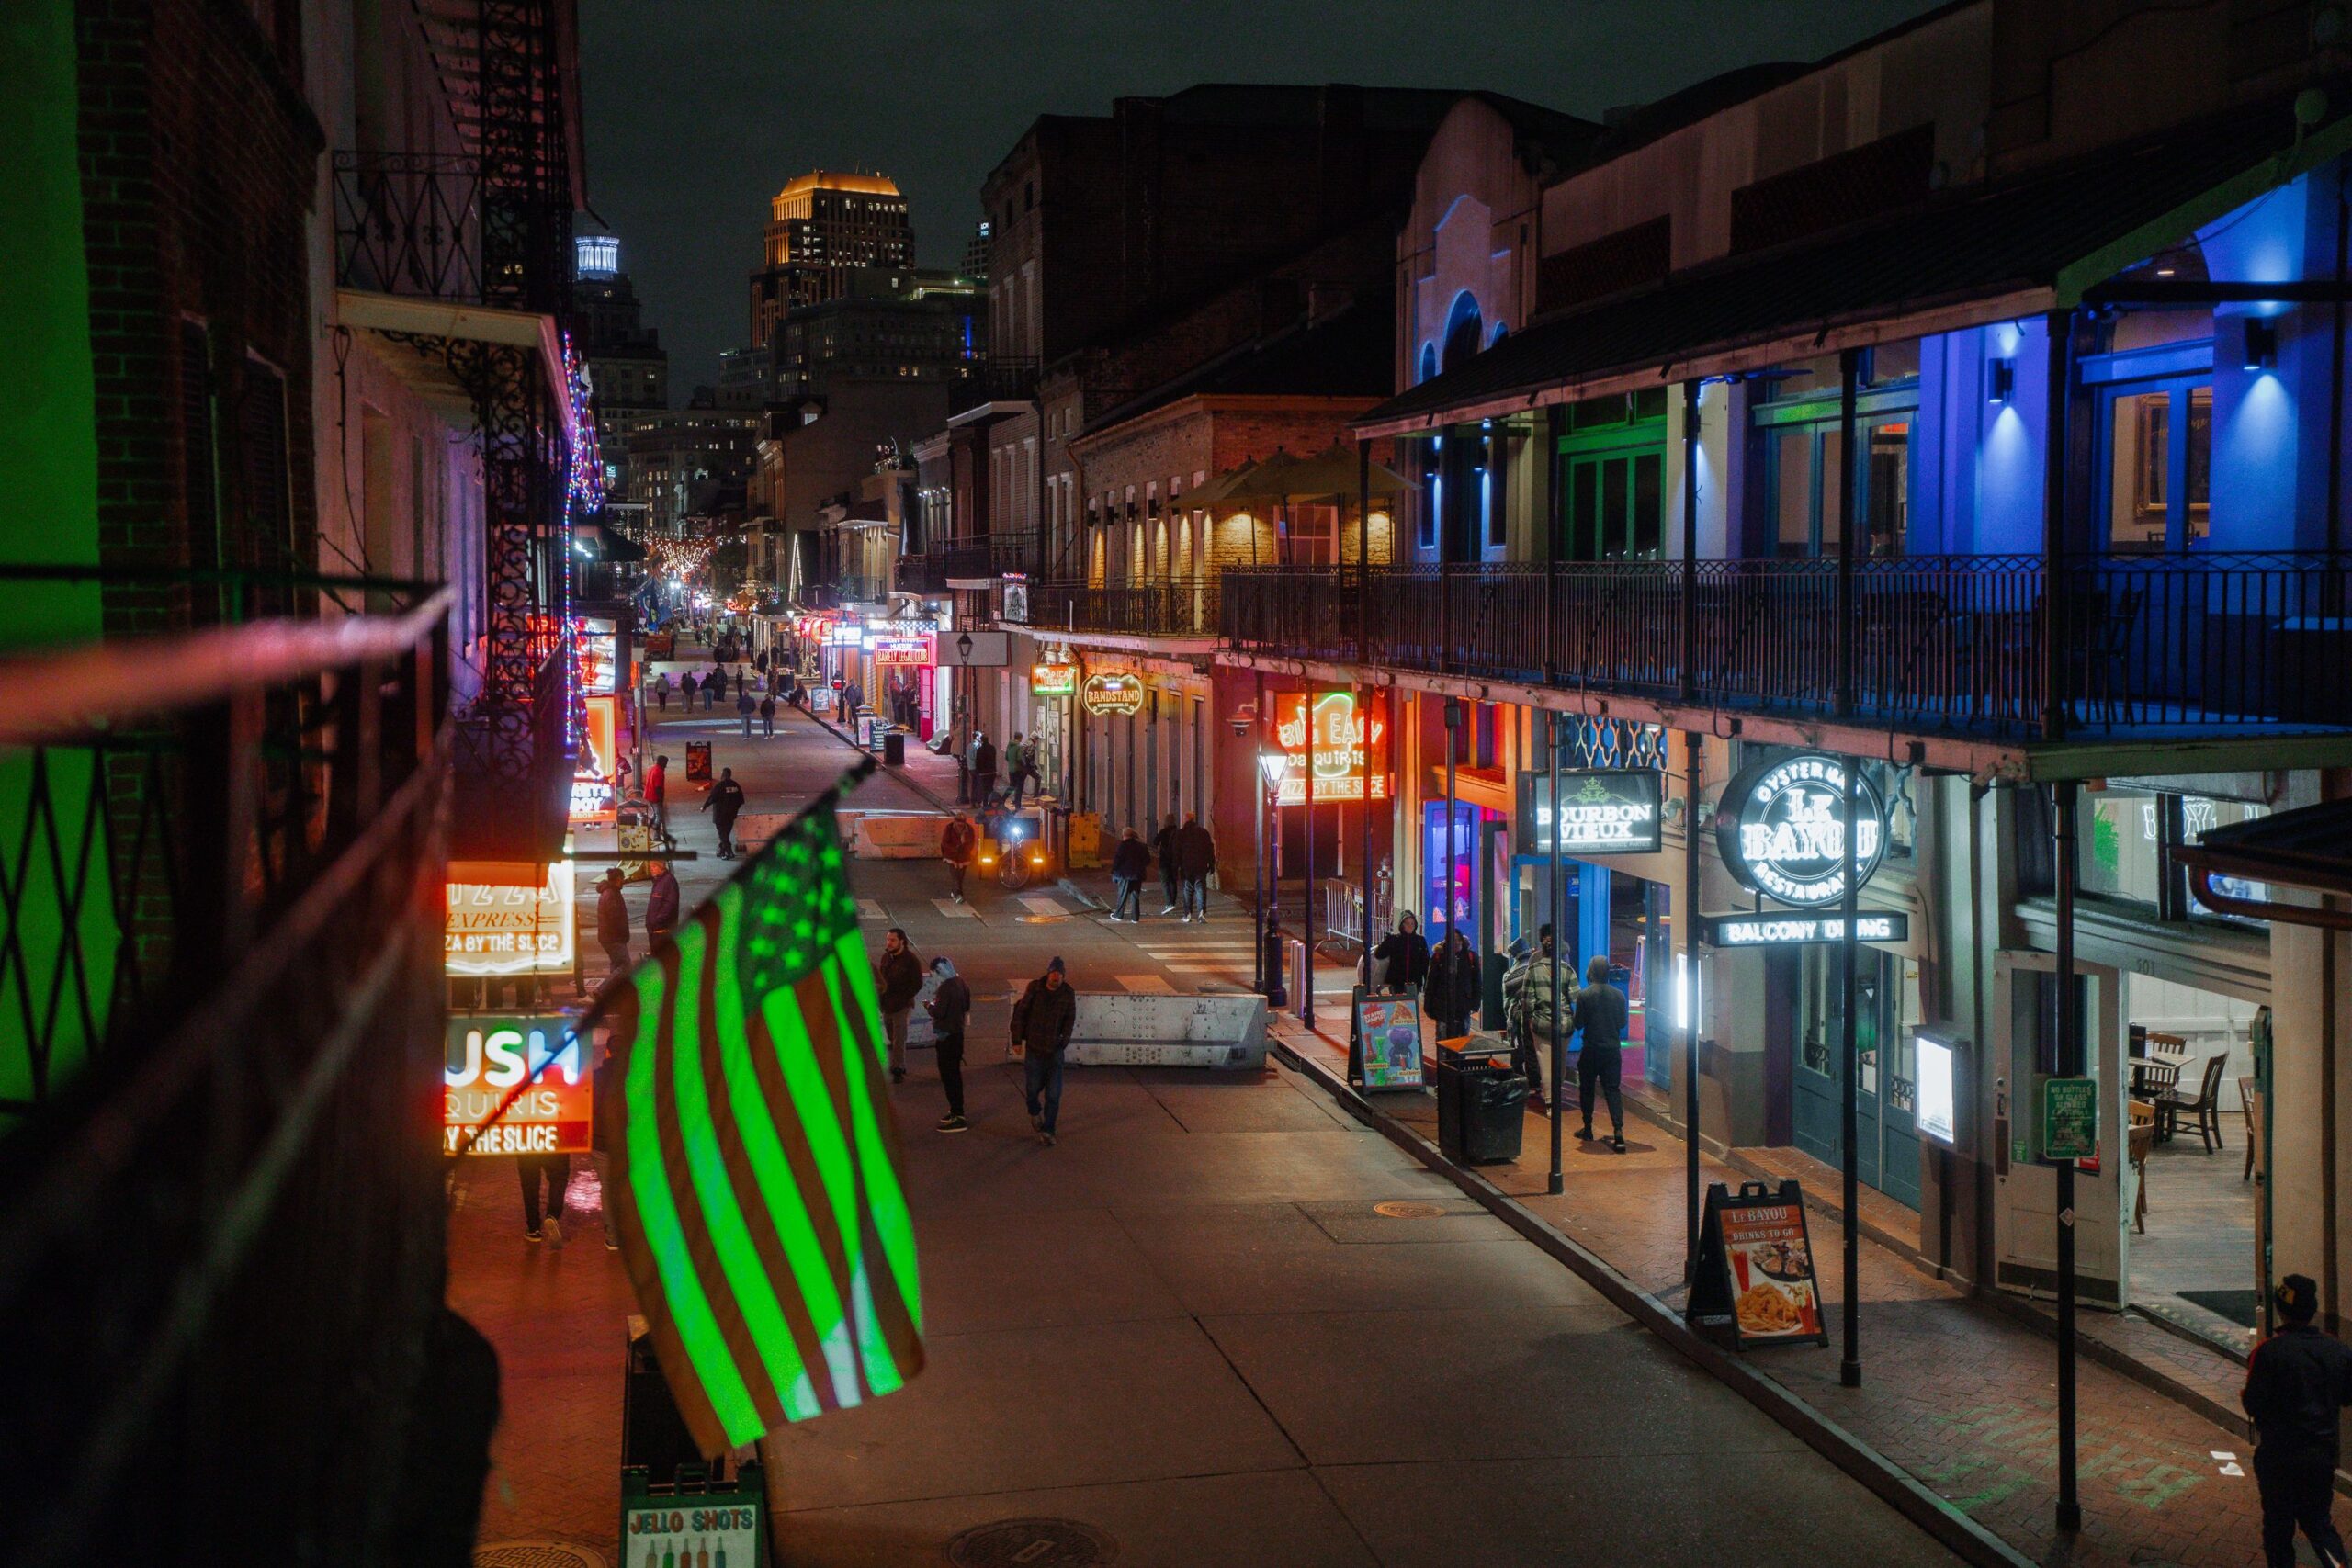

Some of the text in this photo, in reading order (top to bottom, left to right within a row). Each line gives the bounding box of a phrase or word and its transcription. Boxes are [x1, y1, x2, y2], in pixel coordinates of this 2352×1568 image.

[1088, 690, 1140, 703] BANDSTAND
[1330, 779, 1351, 795] THE
[1353, 778, 1384, 795] SLCE
[1756, 761, 1823, 803] OYSTER
[1537, 805, 1652, 825] BOURBON
[1560, 822, 1633, 840] VIEUX
[1741, 819, 1878, 860] BAYOU
[446, 911, 537, 929] EXPRESS
[1728, 921, 1816, 942] BALCONY
[465, 934, 484, 952] BY
[489, 932, 514, 952] THE
[445, 1030, 580, 1089] USH
[503, 1124, 559, 1153] SLICE
[1748, 1206, 1788, 1222] BAYOU
[1733, 1228, 1793, 1241] DRINKS TO GO
[630, 1508, 753, 1535] JELLO SHOTS
